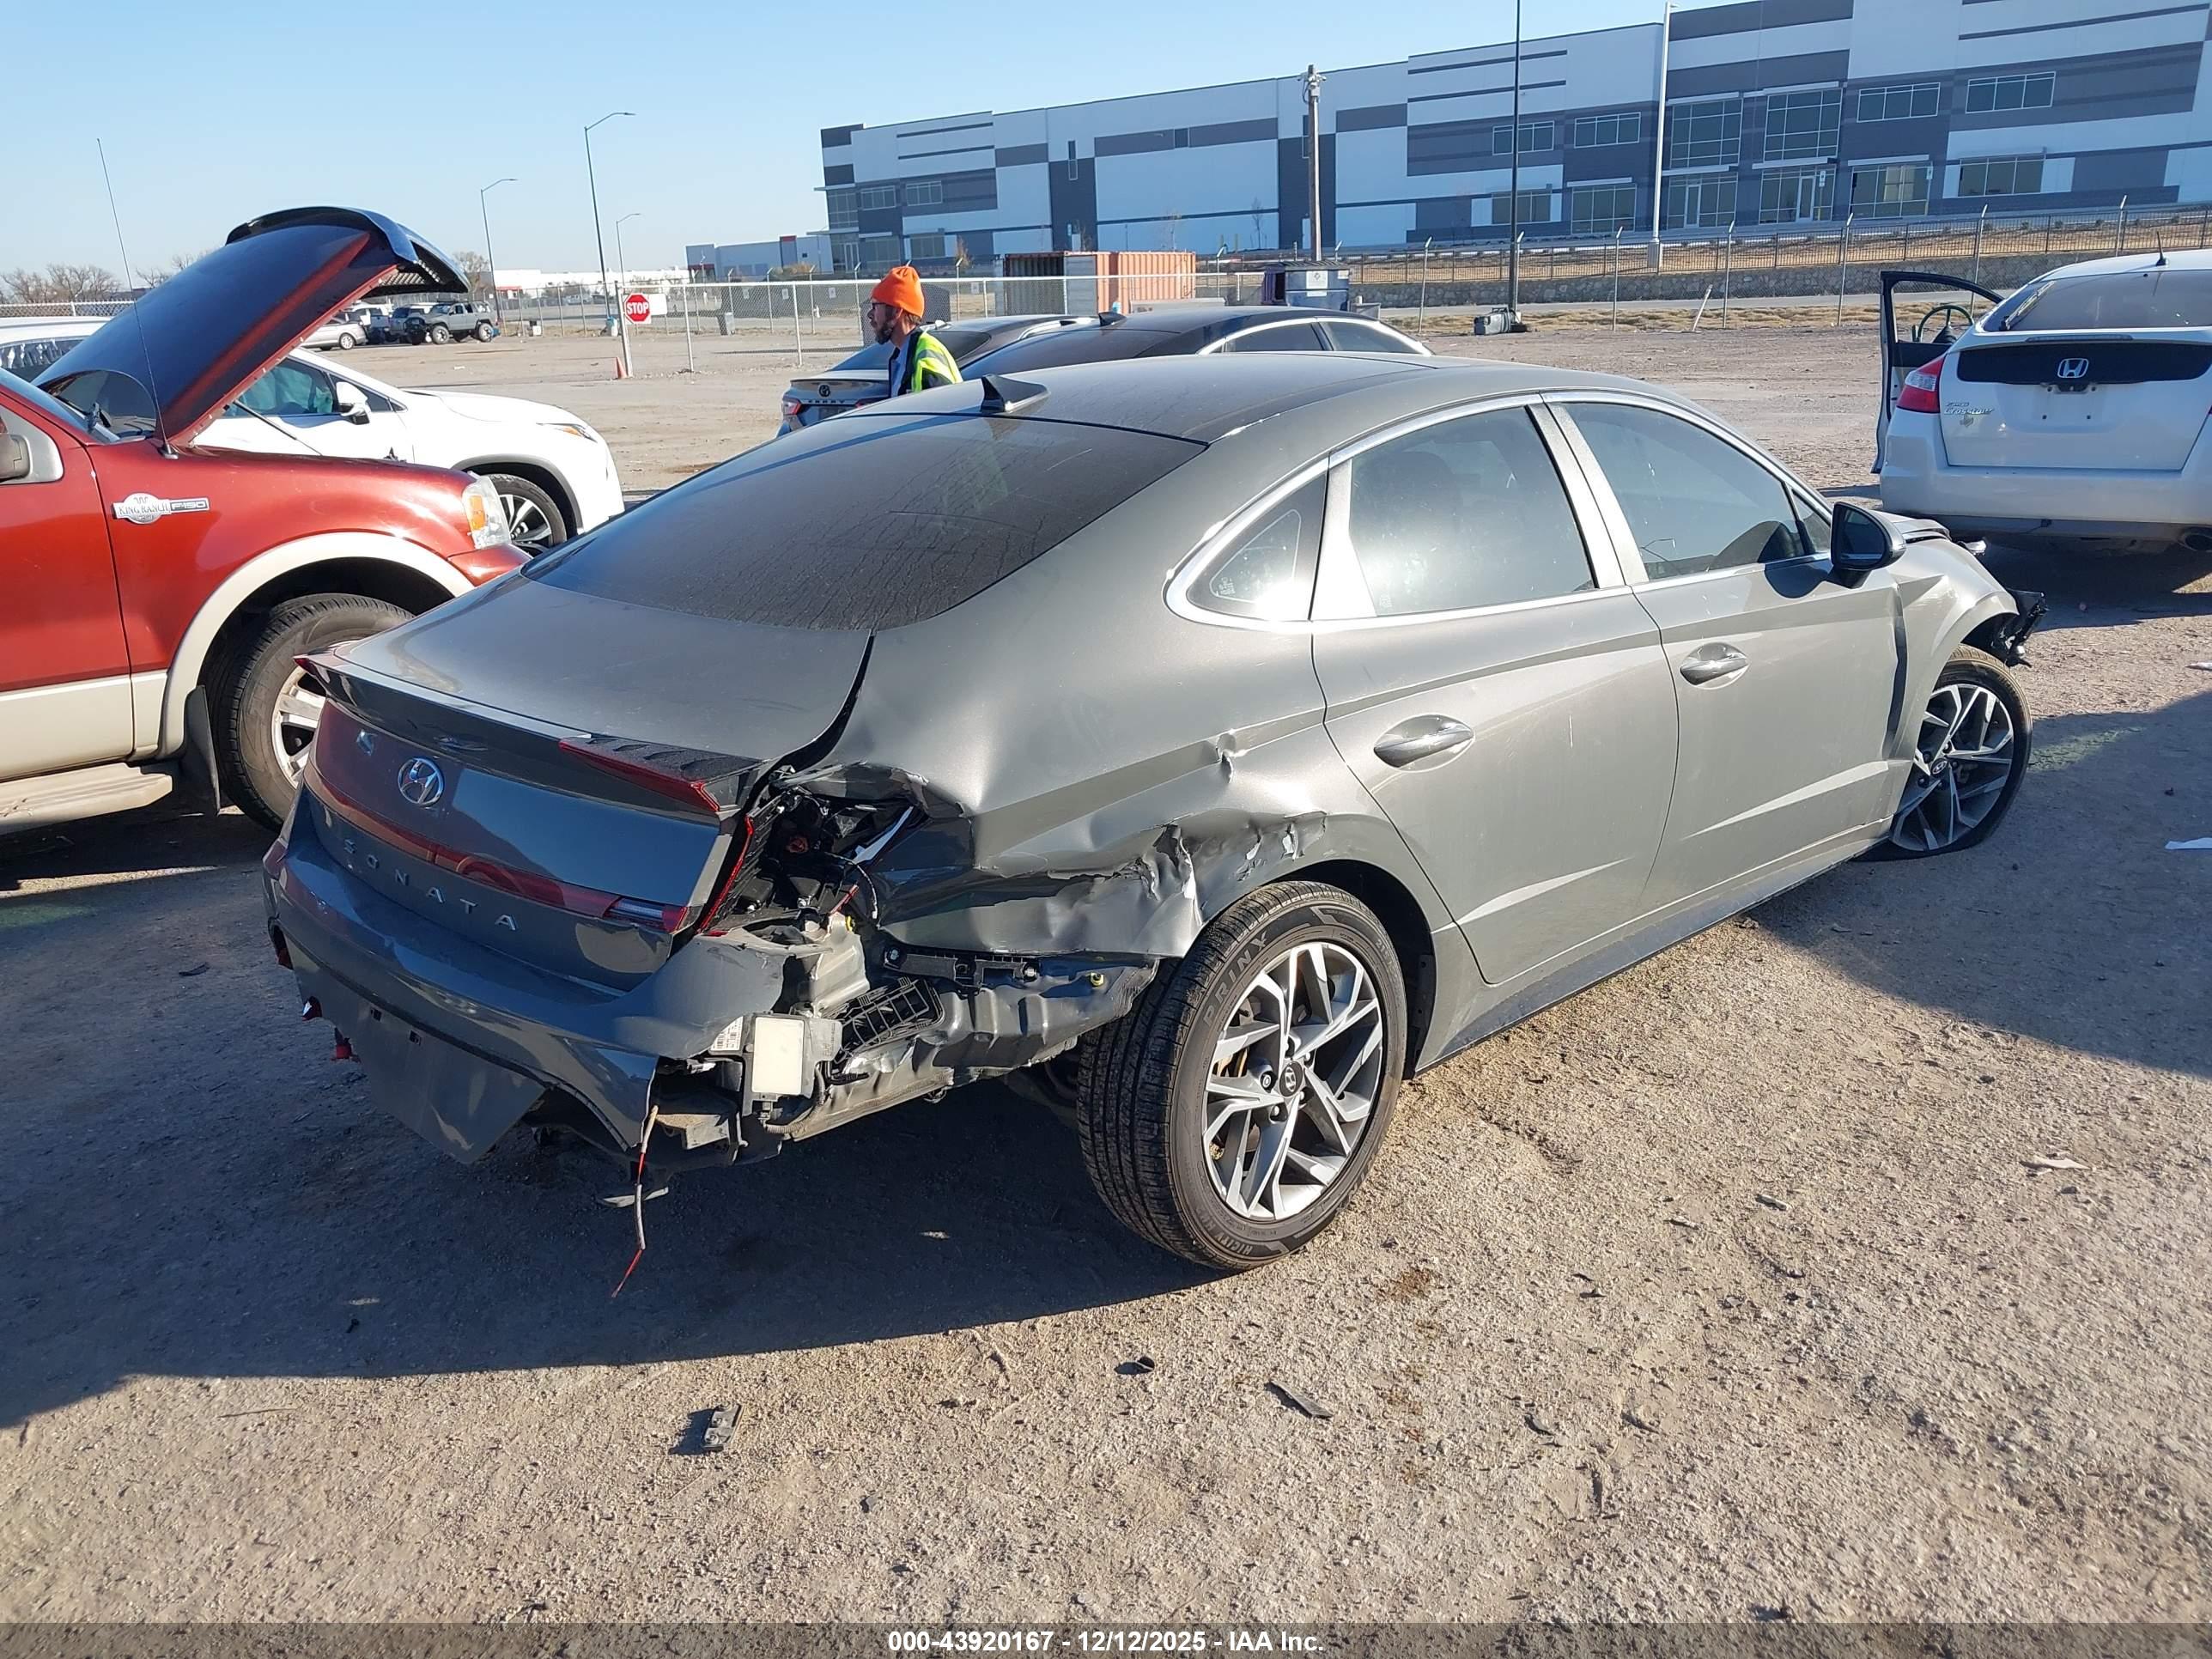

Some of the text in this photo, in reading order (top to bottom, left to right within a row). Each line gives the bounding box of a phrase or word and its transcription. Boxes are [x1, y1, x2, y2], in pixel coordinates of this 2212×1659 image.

[627, 302, 649, 314] STOP
[118, 503, 169, 515] KING RANCH
[171, 501, 206, 510] F-150
[343, 839, 517, 931] SONATA
[1203, 931, 1267, 1026] PRINX
[1215, 1232, 1253, 1255] HICITY
